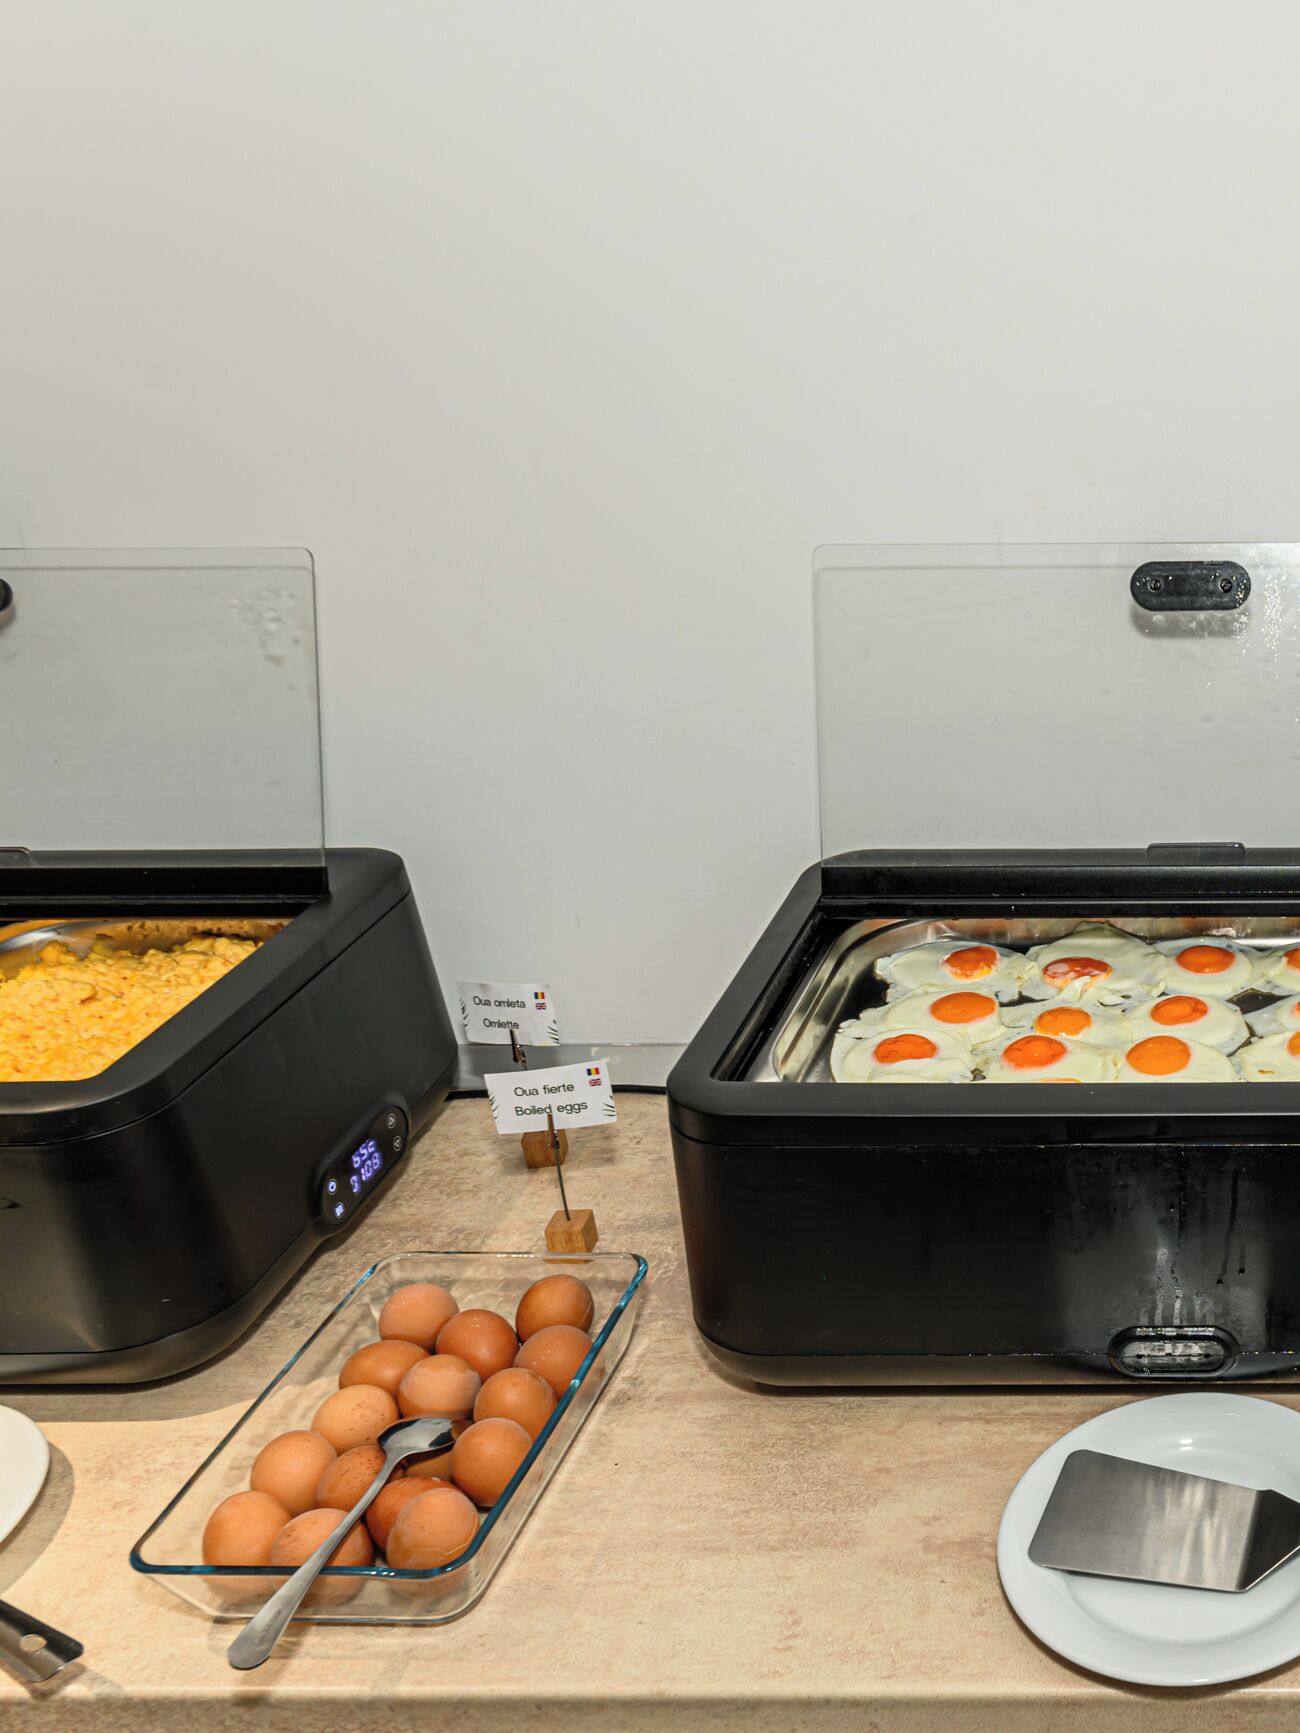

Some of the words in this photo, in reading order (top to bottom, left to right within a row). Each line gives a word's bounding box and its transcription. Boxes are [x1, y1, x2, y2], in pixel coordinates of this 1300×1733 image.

[472, 995, 492, 1007] Oua
[493, 998, 526, 1009] omleta
[482, 1018, 520, 1030] Omlette
[513, 1086, 539, 1097] Oua
[542, 1083, 575, 1095] fierte
[514, 1104, 552, 1116] Boiled
[556, 1101, 588, 1115] eggs
